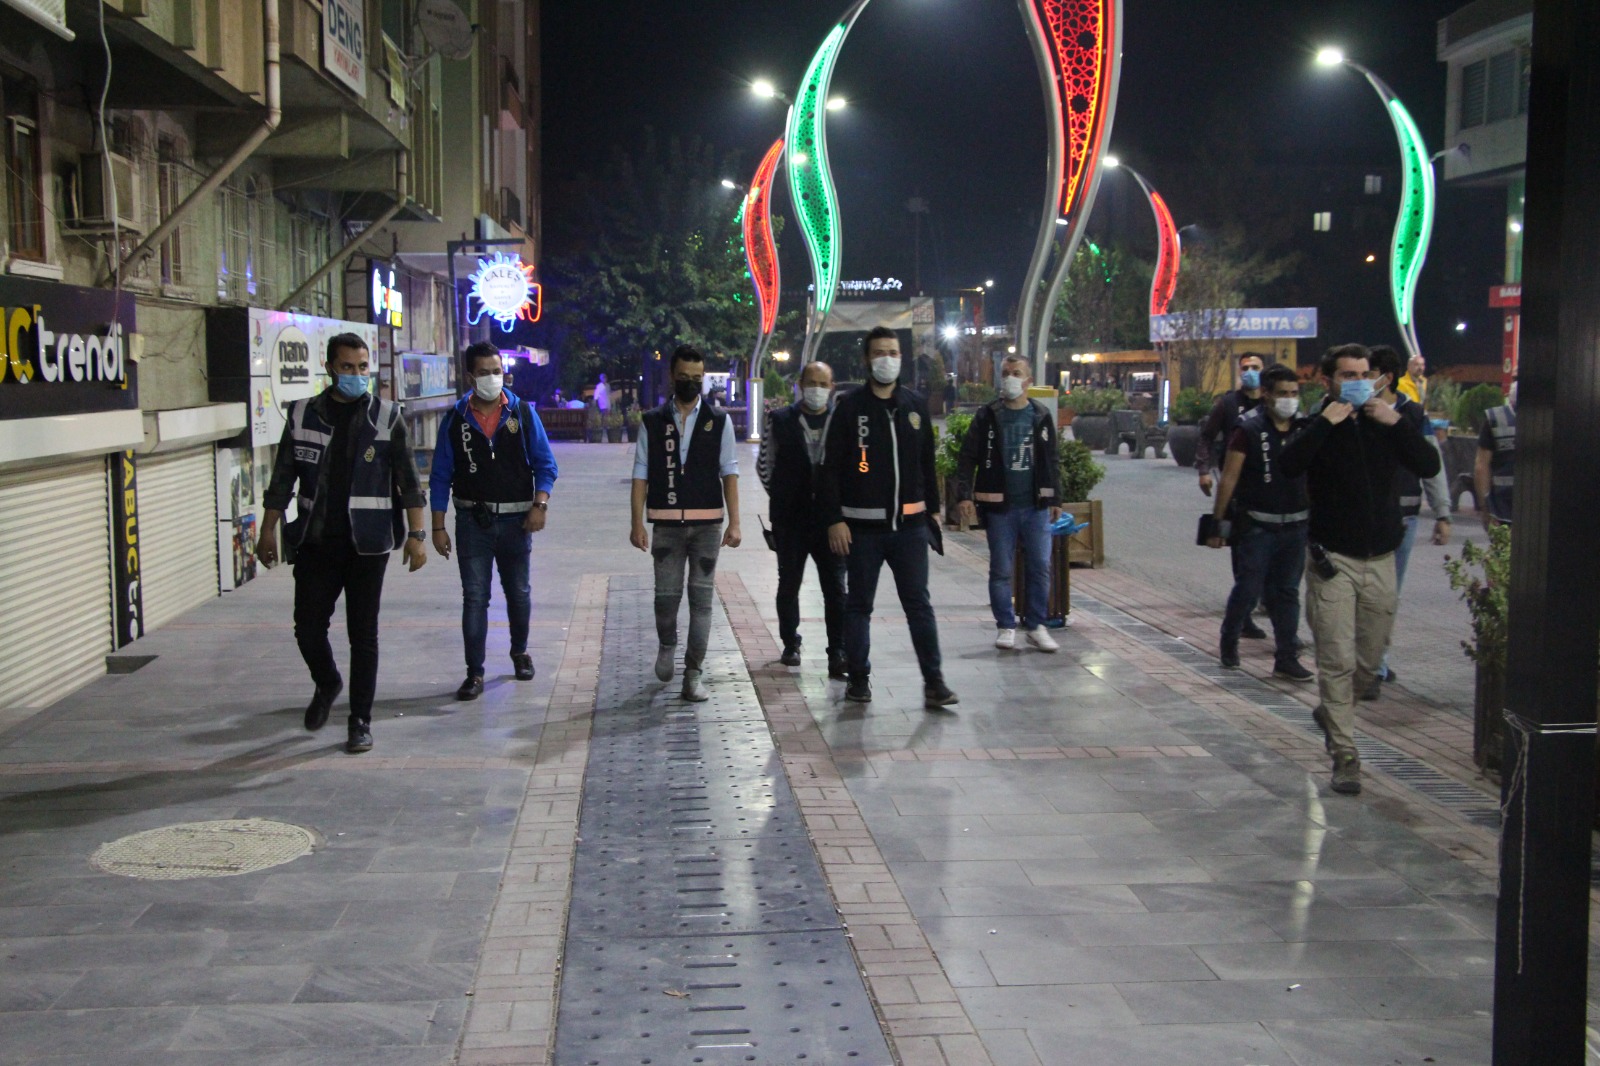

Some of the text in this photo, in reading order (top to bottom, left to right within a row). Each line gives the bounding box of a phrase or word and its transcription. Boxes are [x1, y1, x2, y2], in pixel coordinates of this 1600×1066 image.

[327, 0, 362, 60] DENG
[1228, 316, 1290, 331] ZABITA
[37, 315, 124, 382] trendi
[279, 341, 309, 363] nano
